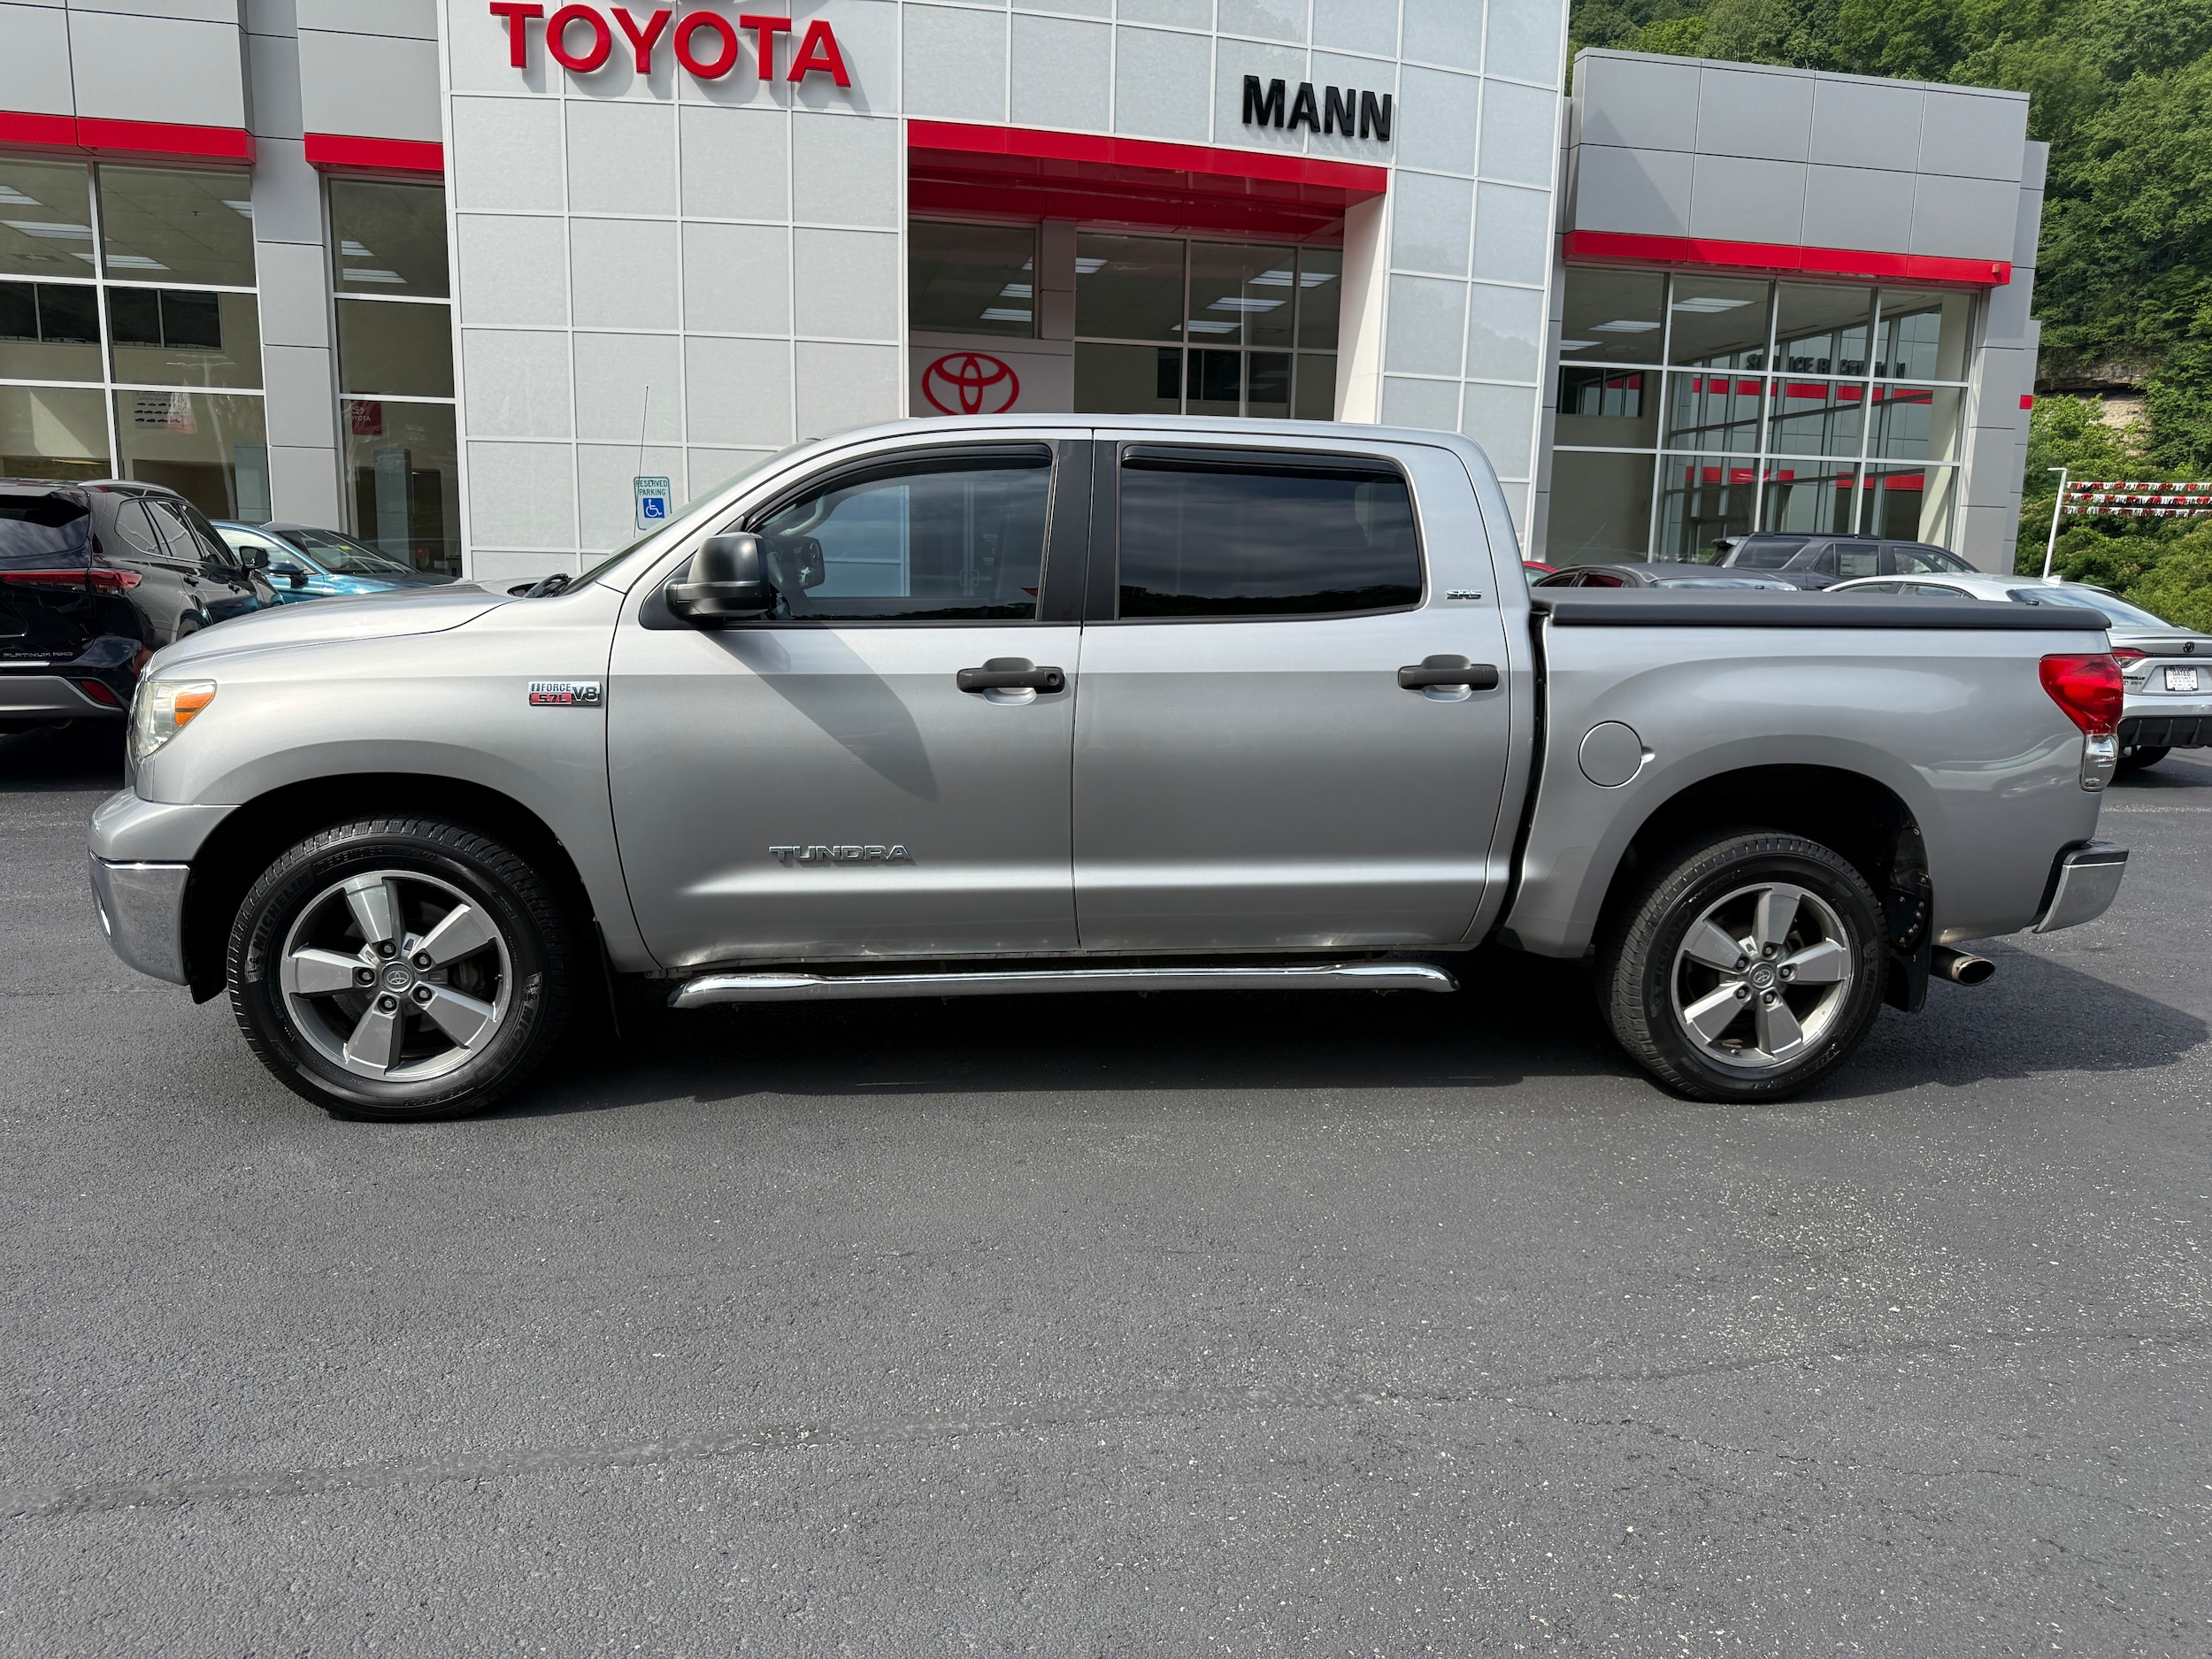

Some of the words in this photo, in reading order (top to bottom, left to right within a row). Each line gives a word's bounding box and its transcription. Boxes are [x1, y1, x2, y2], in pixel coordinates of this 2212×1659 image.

[490, 2, 851, 88] TOYOTA
[1242, 74, 1392, 142] MANN
[572, 687, 598, 702] V8
[769, 845, 912, 862] TUNDRA
[251, 868, 313, 953] MICHELIN
